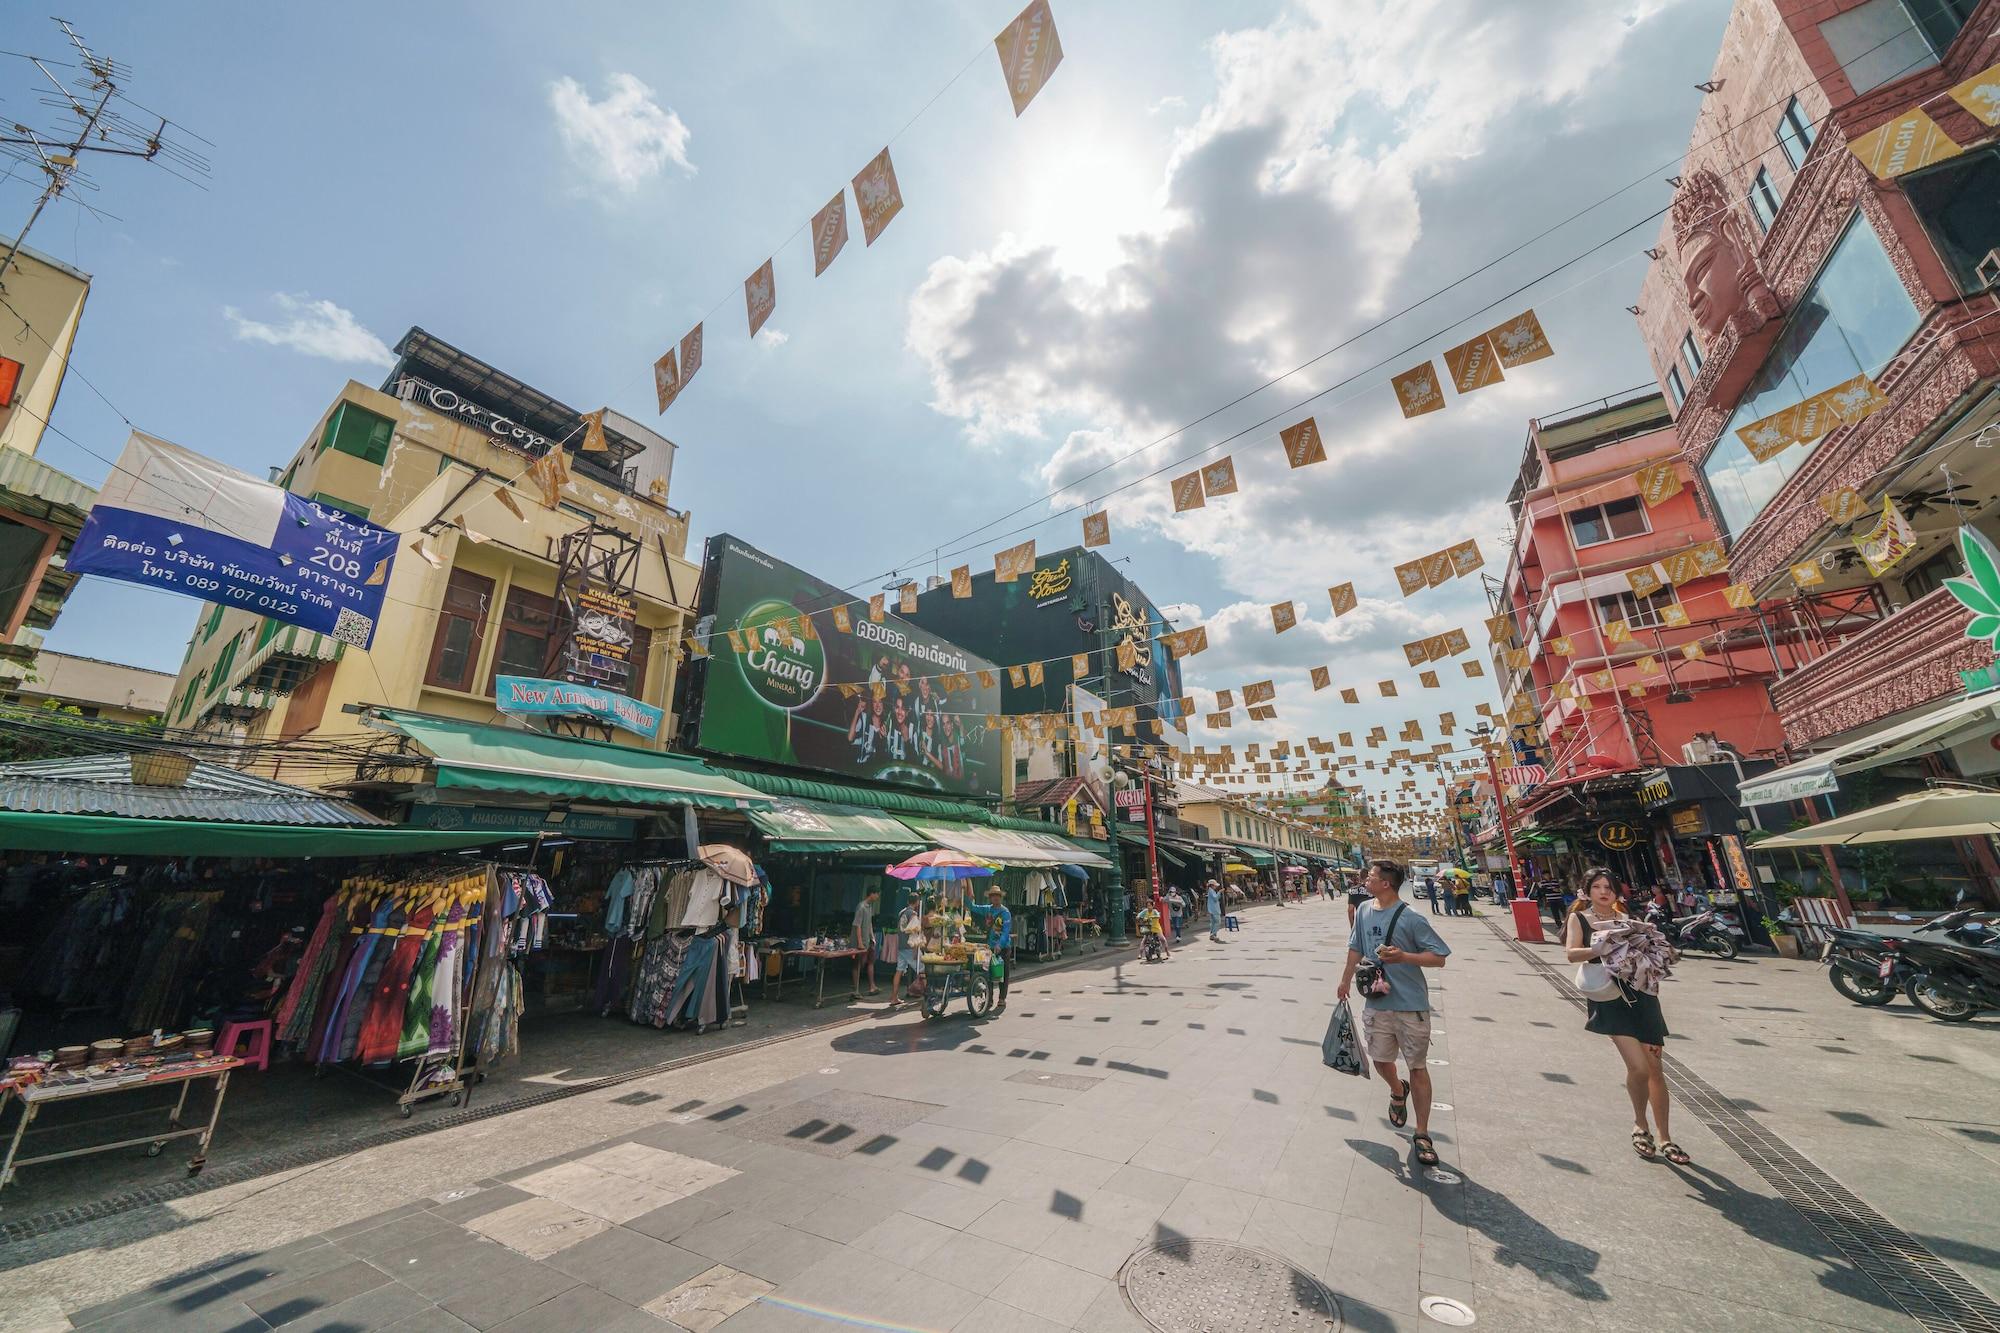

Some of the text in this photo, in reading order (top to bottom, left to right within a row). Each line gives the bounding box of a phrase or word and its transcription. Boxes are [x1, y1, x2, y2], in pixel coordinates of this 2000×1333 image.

[1017, 10, 1043, 94] SINGHA
[1886, 120, 1919, 175] SINGHA
[866, 194, 897, 226] SINGHA
[819, 204, 842, 262] SINGHA
[1462, 343, 1485, 390] SINGHA
[1503, 339, 1545, 364] SINGHA
[424, 385, 481, 416] On
[1405, 392, 1440, 412] SINGHA
[1802, 402, 1819, 438] SINGHA
[1295, 425, 1313, 465] SINGHA
[1179, 477, 1197, 509] SINGHA
[1650, 466, 1670, 500] SINGHA
[325, 527, 363, 555] พื้นที่
[103, 534, 156, 556] ติดต่อ
[164, 548, 214, 571] บริษัท
[300, 588, 333, 609] จำกัด
[309, 546, 360, 579] 208
[142, 560, 298, 615] โทร. 089 707 0125
[299, 566, 364, 601] ตารางวา
[588, 588, 630, 607] KHAOSAN
[1032, 576, 1071, 599] House
[1037, 595, 1067, 608] AMSTERDAM
[857, 620, 967, 672] คอบอล คอเดียวกัน
[748, 645, 814, 690] Chang
[511, 683, 547, 704] New
[614, 697, 654, 729] Fashion
[1501, 766, 1526, 785] EXIT
[1127, 790, 1143, 805] EXIT
[1633, 781, 1668, 805] TATTOO
[472, 812, 516, 825] KHAOSAN
[518, 816, 540, 827] PARK
[570, 818, 577, 828] &
[578, 819, 618, 831] SHOPPING
